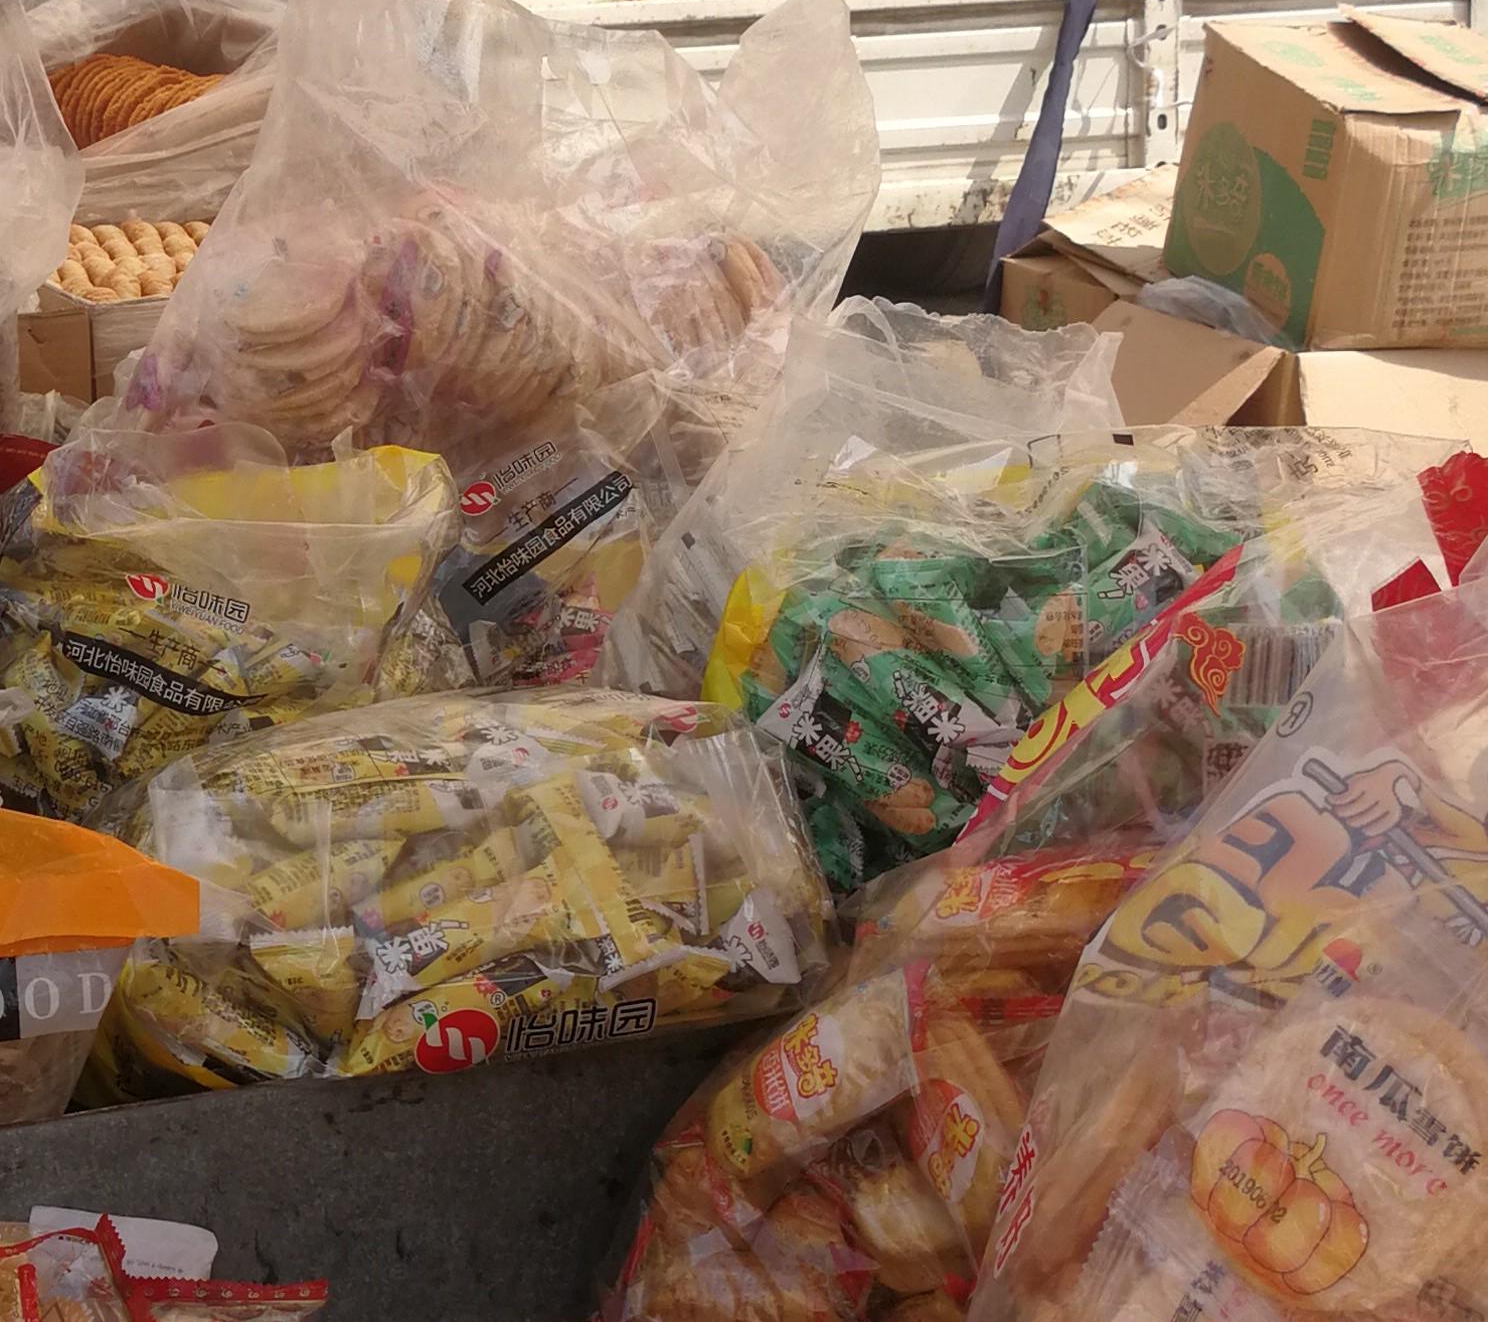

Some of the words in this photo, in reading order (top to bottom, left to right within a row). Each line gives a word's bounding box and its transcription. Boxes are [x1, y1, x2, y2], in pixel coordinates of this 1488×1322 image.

[470, 473, 633, 599] 河北怡味园食品有限公司
[505, 997, 656, 1053] 怡味园
[1307, 1073, 1369, 1127] once
[1371, 1128, 1448, 1196] more
